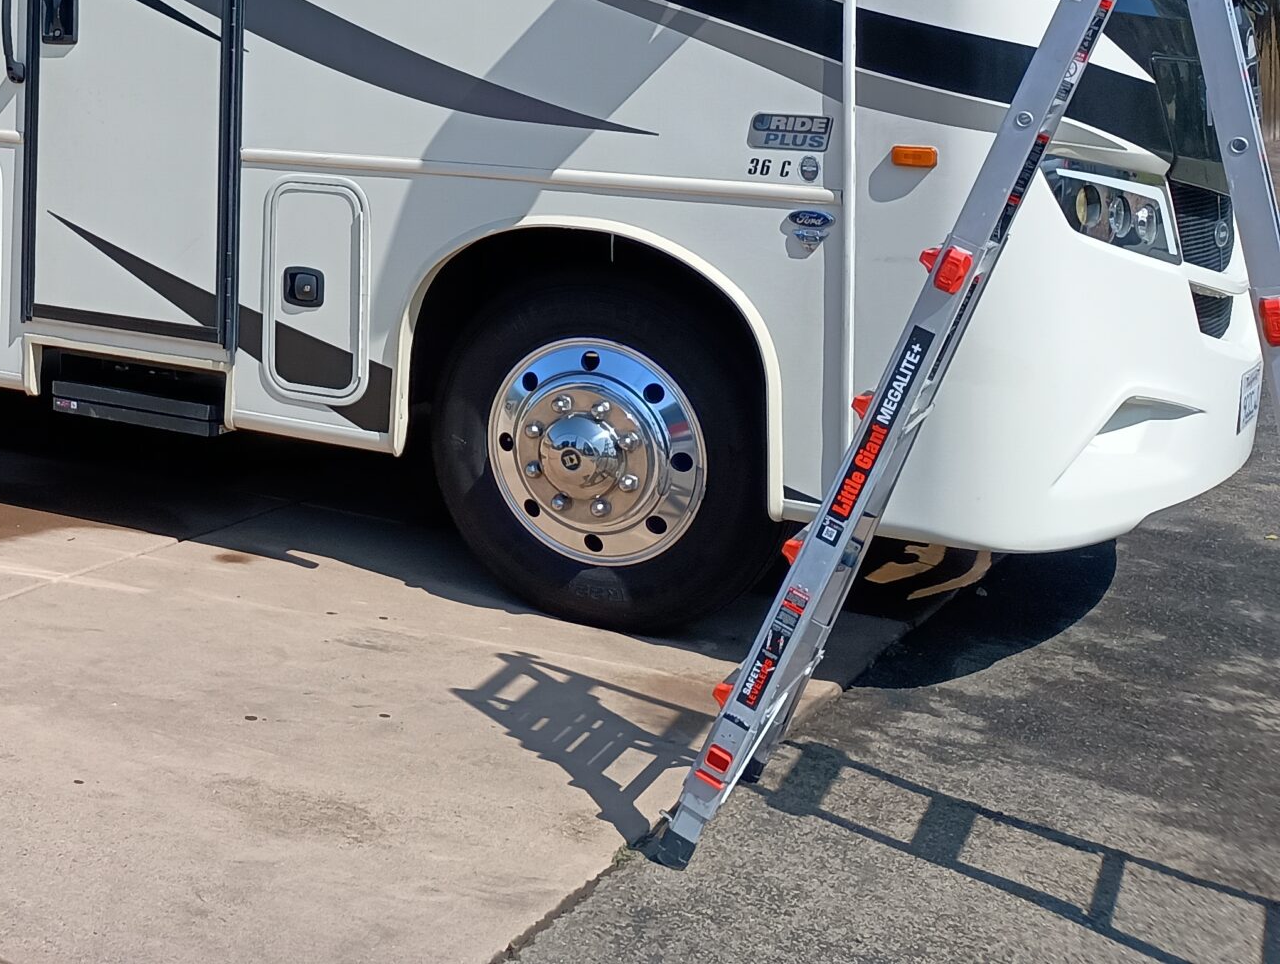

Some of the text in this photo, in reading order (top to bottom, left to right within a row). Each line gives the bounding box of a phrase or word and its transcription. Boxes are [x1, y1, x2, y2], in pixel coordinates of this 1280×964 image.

[764, 132, 825, 148] PLUS
[748, 157, 792, 178] 36 C
[796, 212, 825, 226] Ford
[831, 343, 922, 517] Little Giant MEGALITE+
[742, 659, 763, 696] SAFETY
[745, 658, 774, 705] LEVELERS
